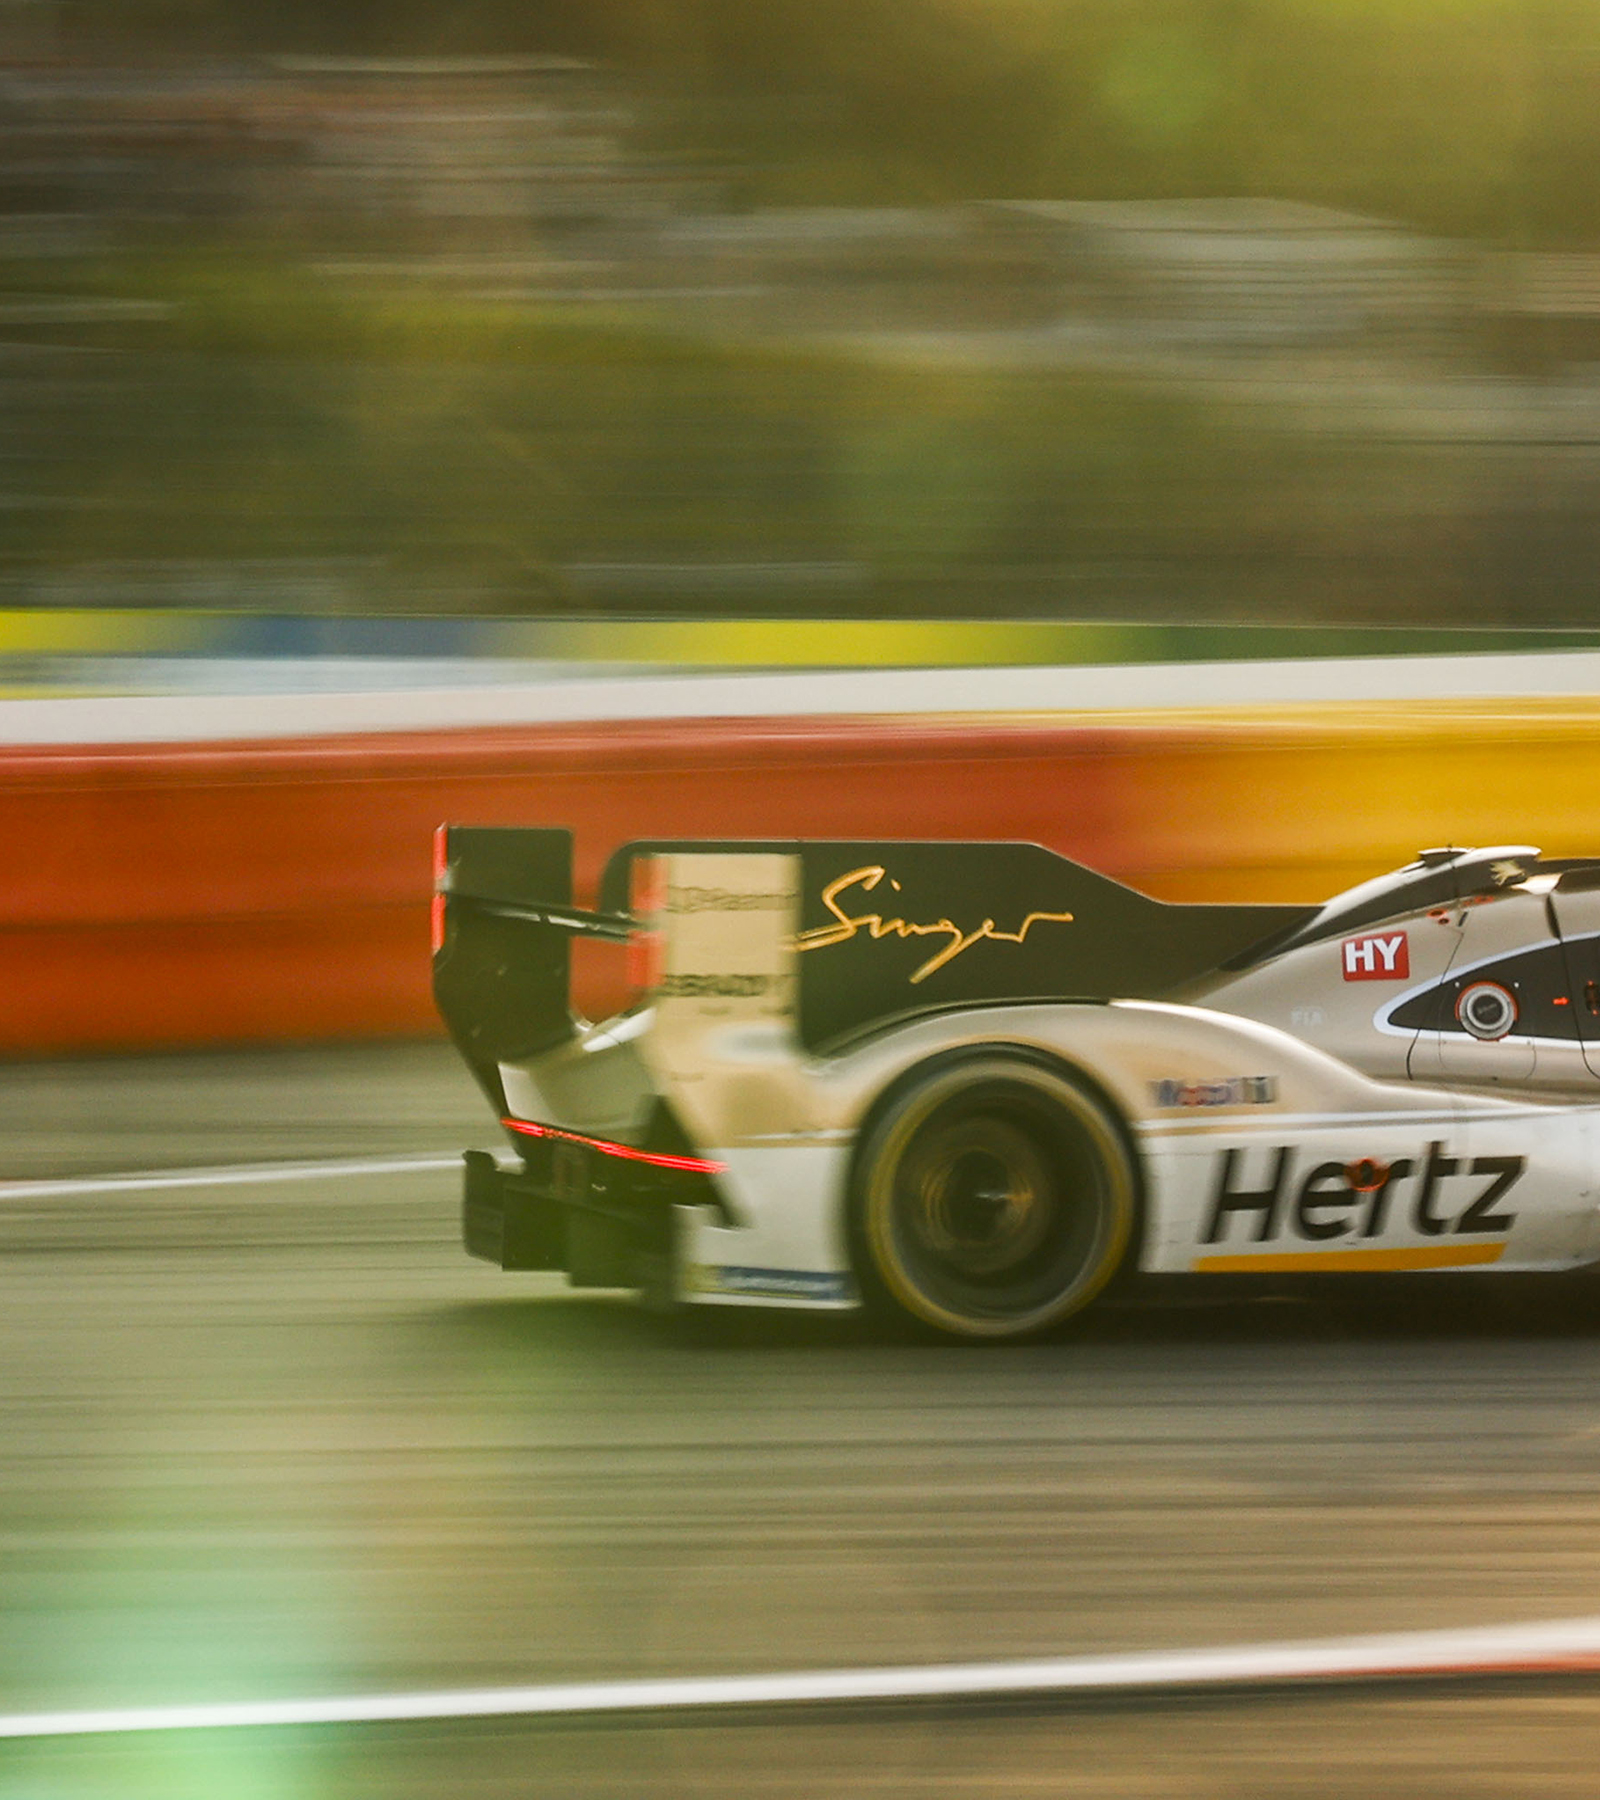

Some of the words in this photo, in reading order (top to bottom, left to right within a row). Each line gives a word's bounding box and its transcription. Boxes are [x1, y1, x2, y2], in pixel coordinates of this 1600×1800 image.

[782, 865, 1074, 984] Singer
[1345, 936, 1404, 973] HY
[1197, 1140, 1528, 1245] Hertz
